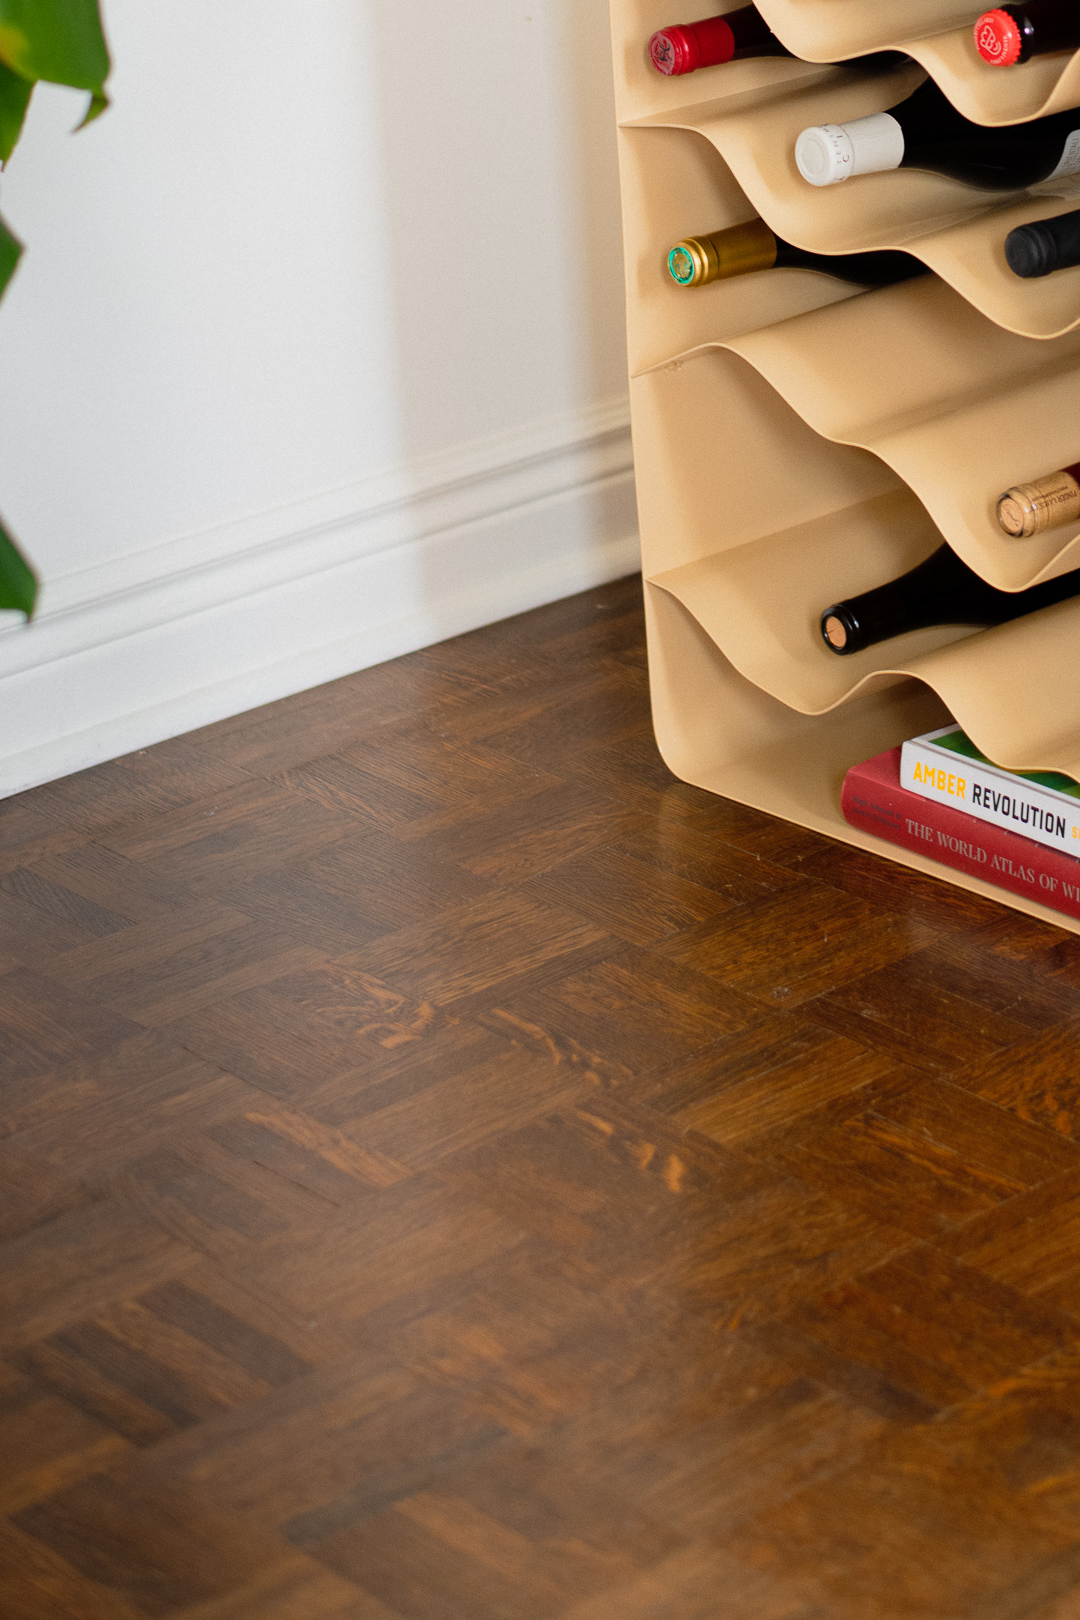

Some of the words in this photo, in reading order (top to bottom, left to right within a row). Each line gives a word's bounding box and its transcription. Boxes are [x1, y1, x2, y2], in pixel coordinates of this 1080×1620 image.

[913, 761, 966, 800] AMBER
[972, 783, 1066, 838] REVOLUTION
[905, 818, 933, 843] THE
[937, 830, 987, 863] WORLD
[990, 854, 1035, 884] ATLAS
[1038, 873, 1058, 892] OF
